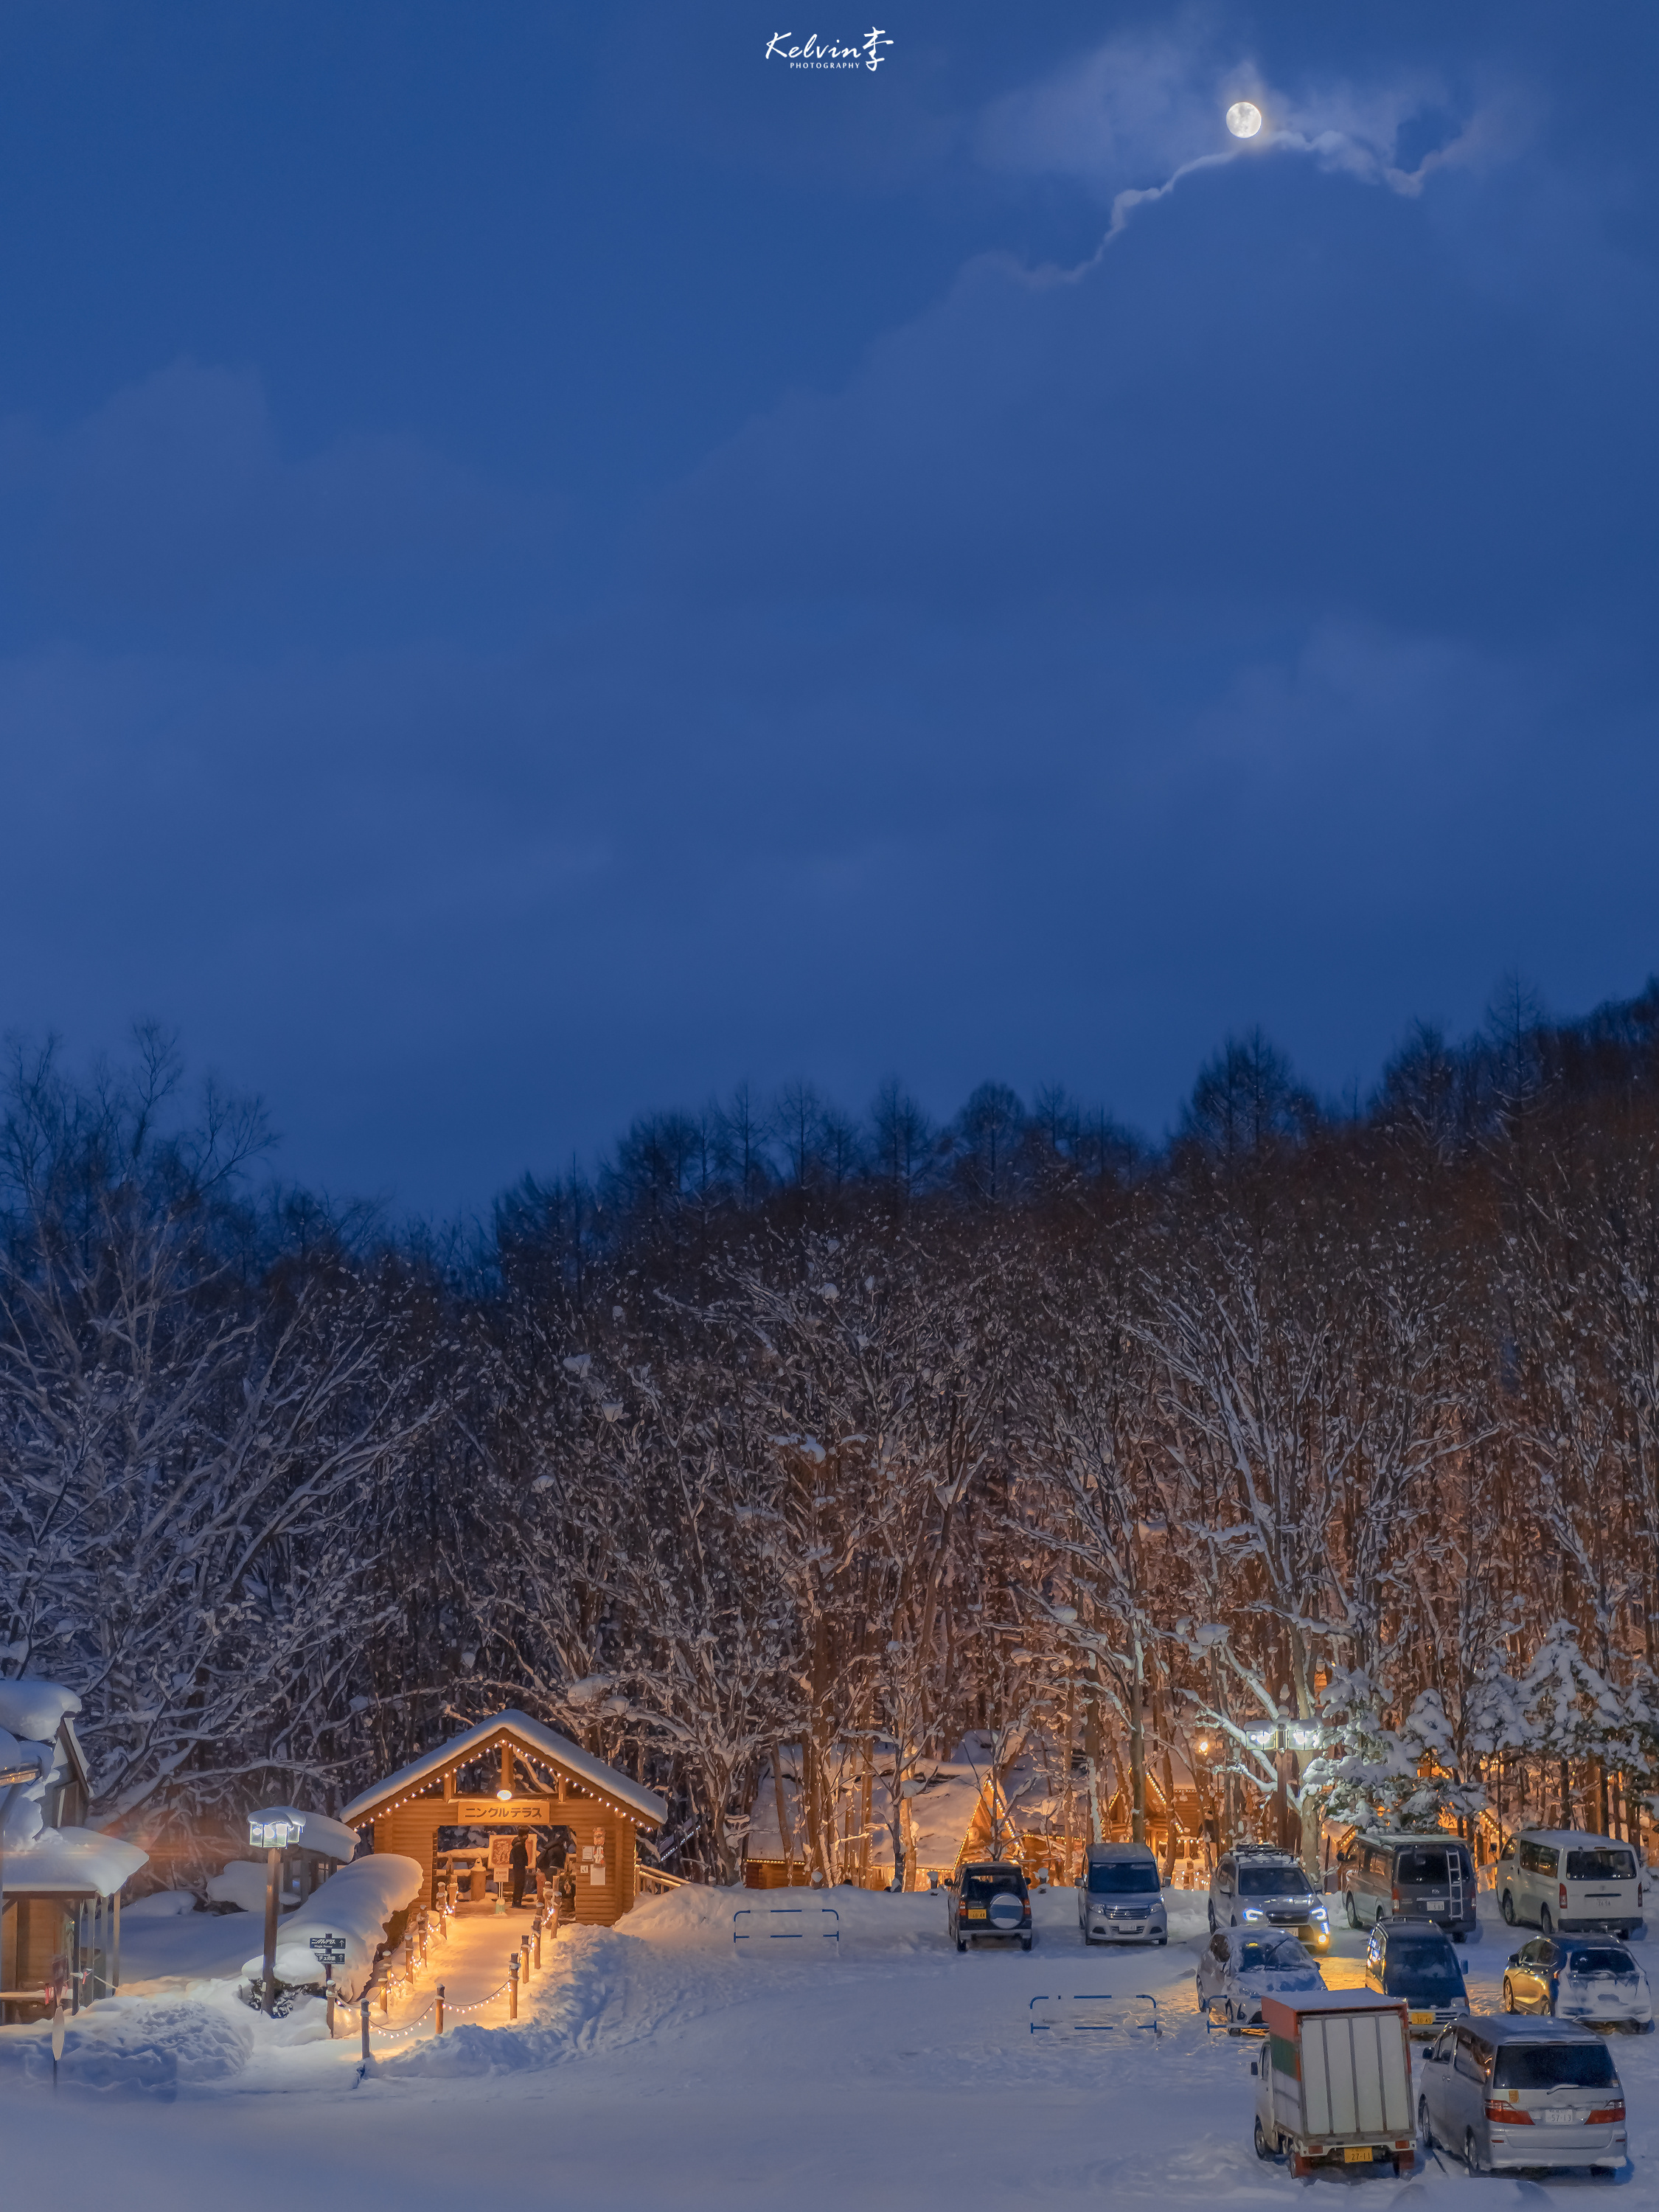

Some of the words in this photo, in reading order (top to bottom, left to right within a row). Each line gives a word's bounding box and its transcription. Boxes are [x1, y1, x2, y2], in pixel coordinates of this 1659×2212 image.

[465, 1806, 543, 1818] ニングルテラス
[1551, 2114, 1571, 2122] 57-13
[1351, 2152, 1371, 2161] 27-11
